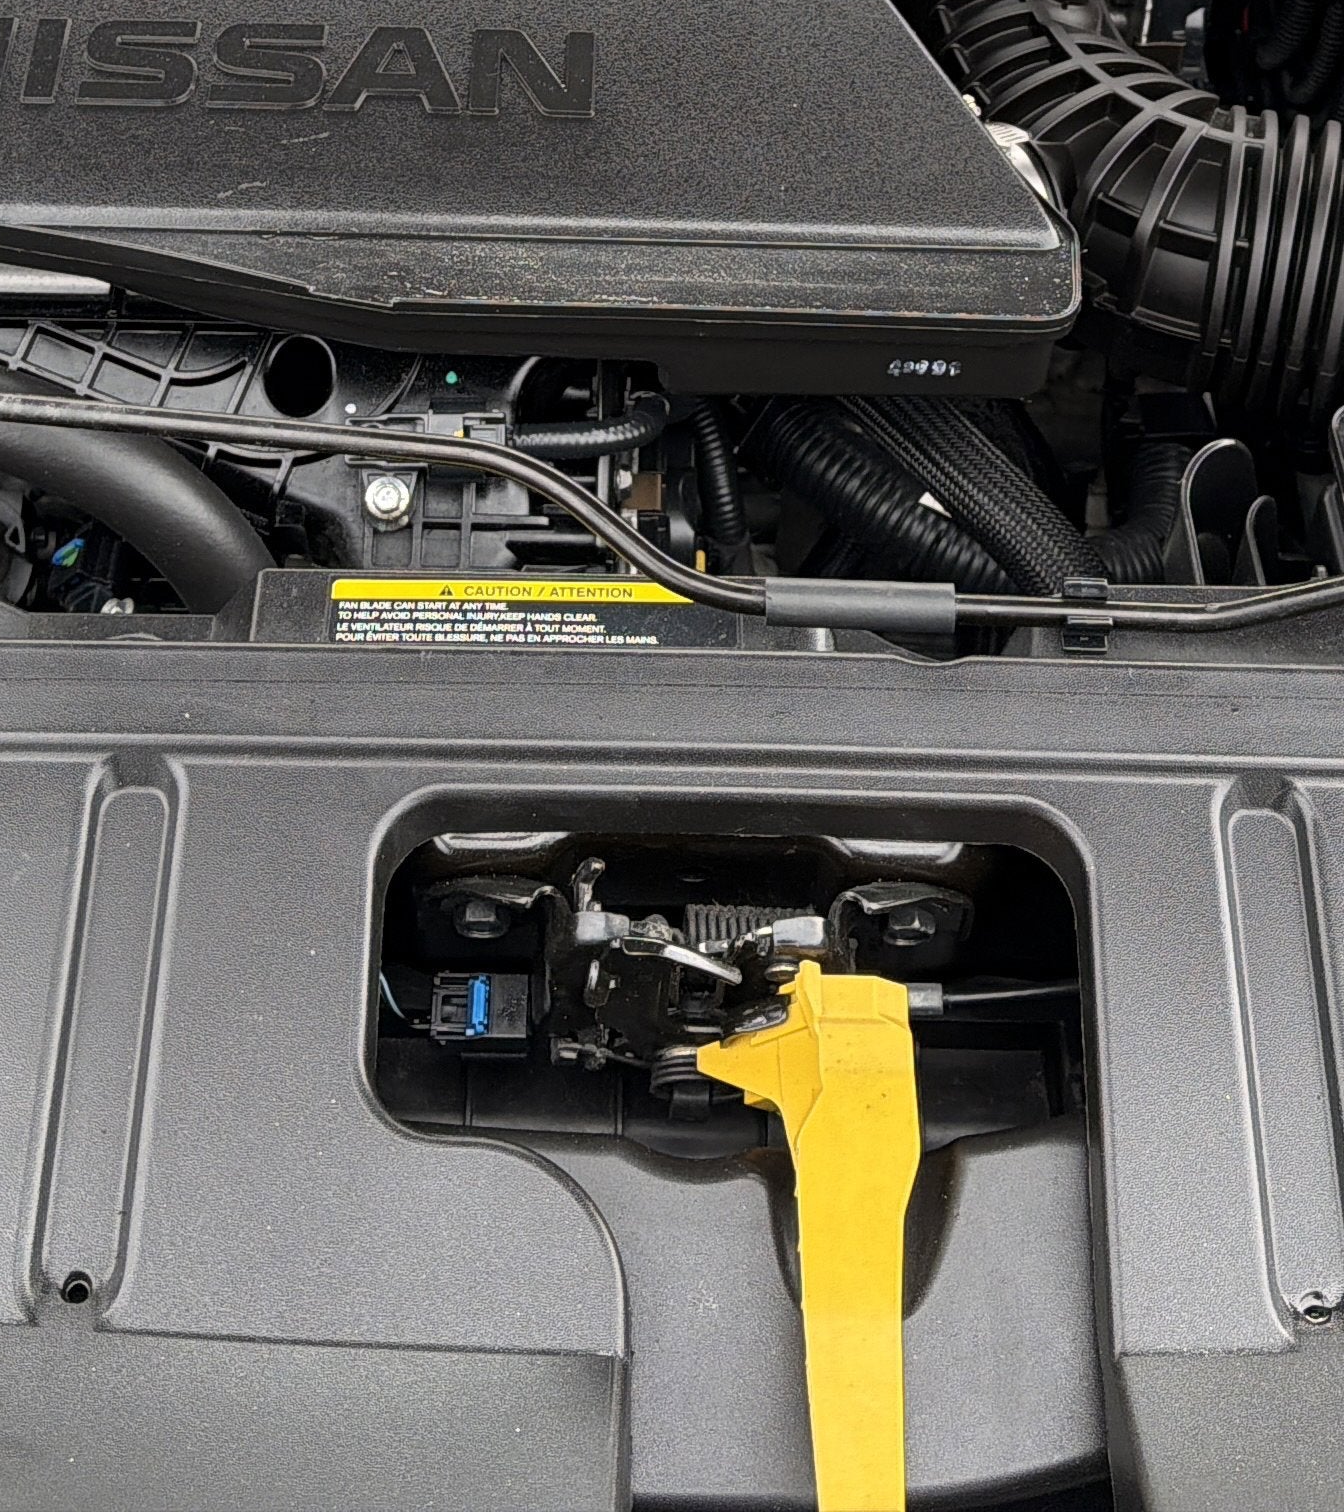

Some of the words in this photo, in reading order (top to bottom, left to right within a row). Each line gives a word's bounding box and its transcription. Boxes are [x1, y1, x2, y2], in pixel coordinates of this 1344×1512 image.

[464, 585, 532, 598] CAUTION
[549, 586, 633, 599] ATTENTION
[339, 601, 359, 610] FAN
[360, 601, 392, 610] BLADE
[393, 601, 416, 610] CAN
[417, 602, 447, 611] START
[448, 602, 461, 611] AT
[462, 602, 483, 611] ANY
[338, 611, 352, 620] TO
[353, 611, 379, 620] HELP
[380, 611, 410, 620] AVOID
[412, 611, 464, 621] PERSONAL
[526, 613, 562, 622] HANDS
[336, 623, 349, 631] LE
[350, 623, 414, 631] VENTILATEUR
[453, 623, 468, 632] DE
[469, 621, 524, 633] DÉMARRER
[534, 624, 560, 633] TOUT
[336, 633, 364, 642] POUR
[365, 631, 400, 642] ÉVITER
[402, 633, 433, 642] TOUTE
[490, 634, 504, 642] NE
[505, 634, 526, 643] PAS
[526, 634, 541, 643] EN
[542, 634, 604, 644] APPROCHER
[605, 635, 624, 644] LES
